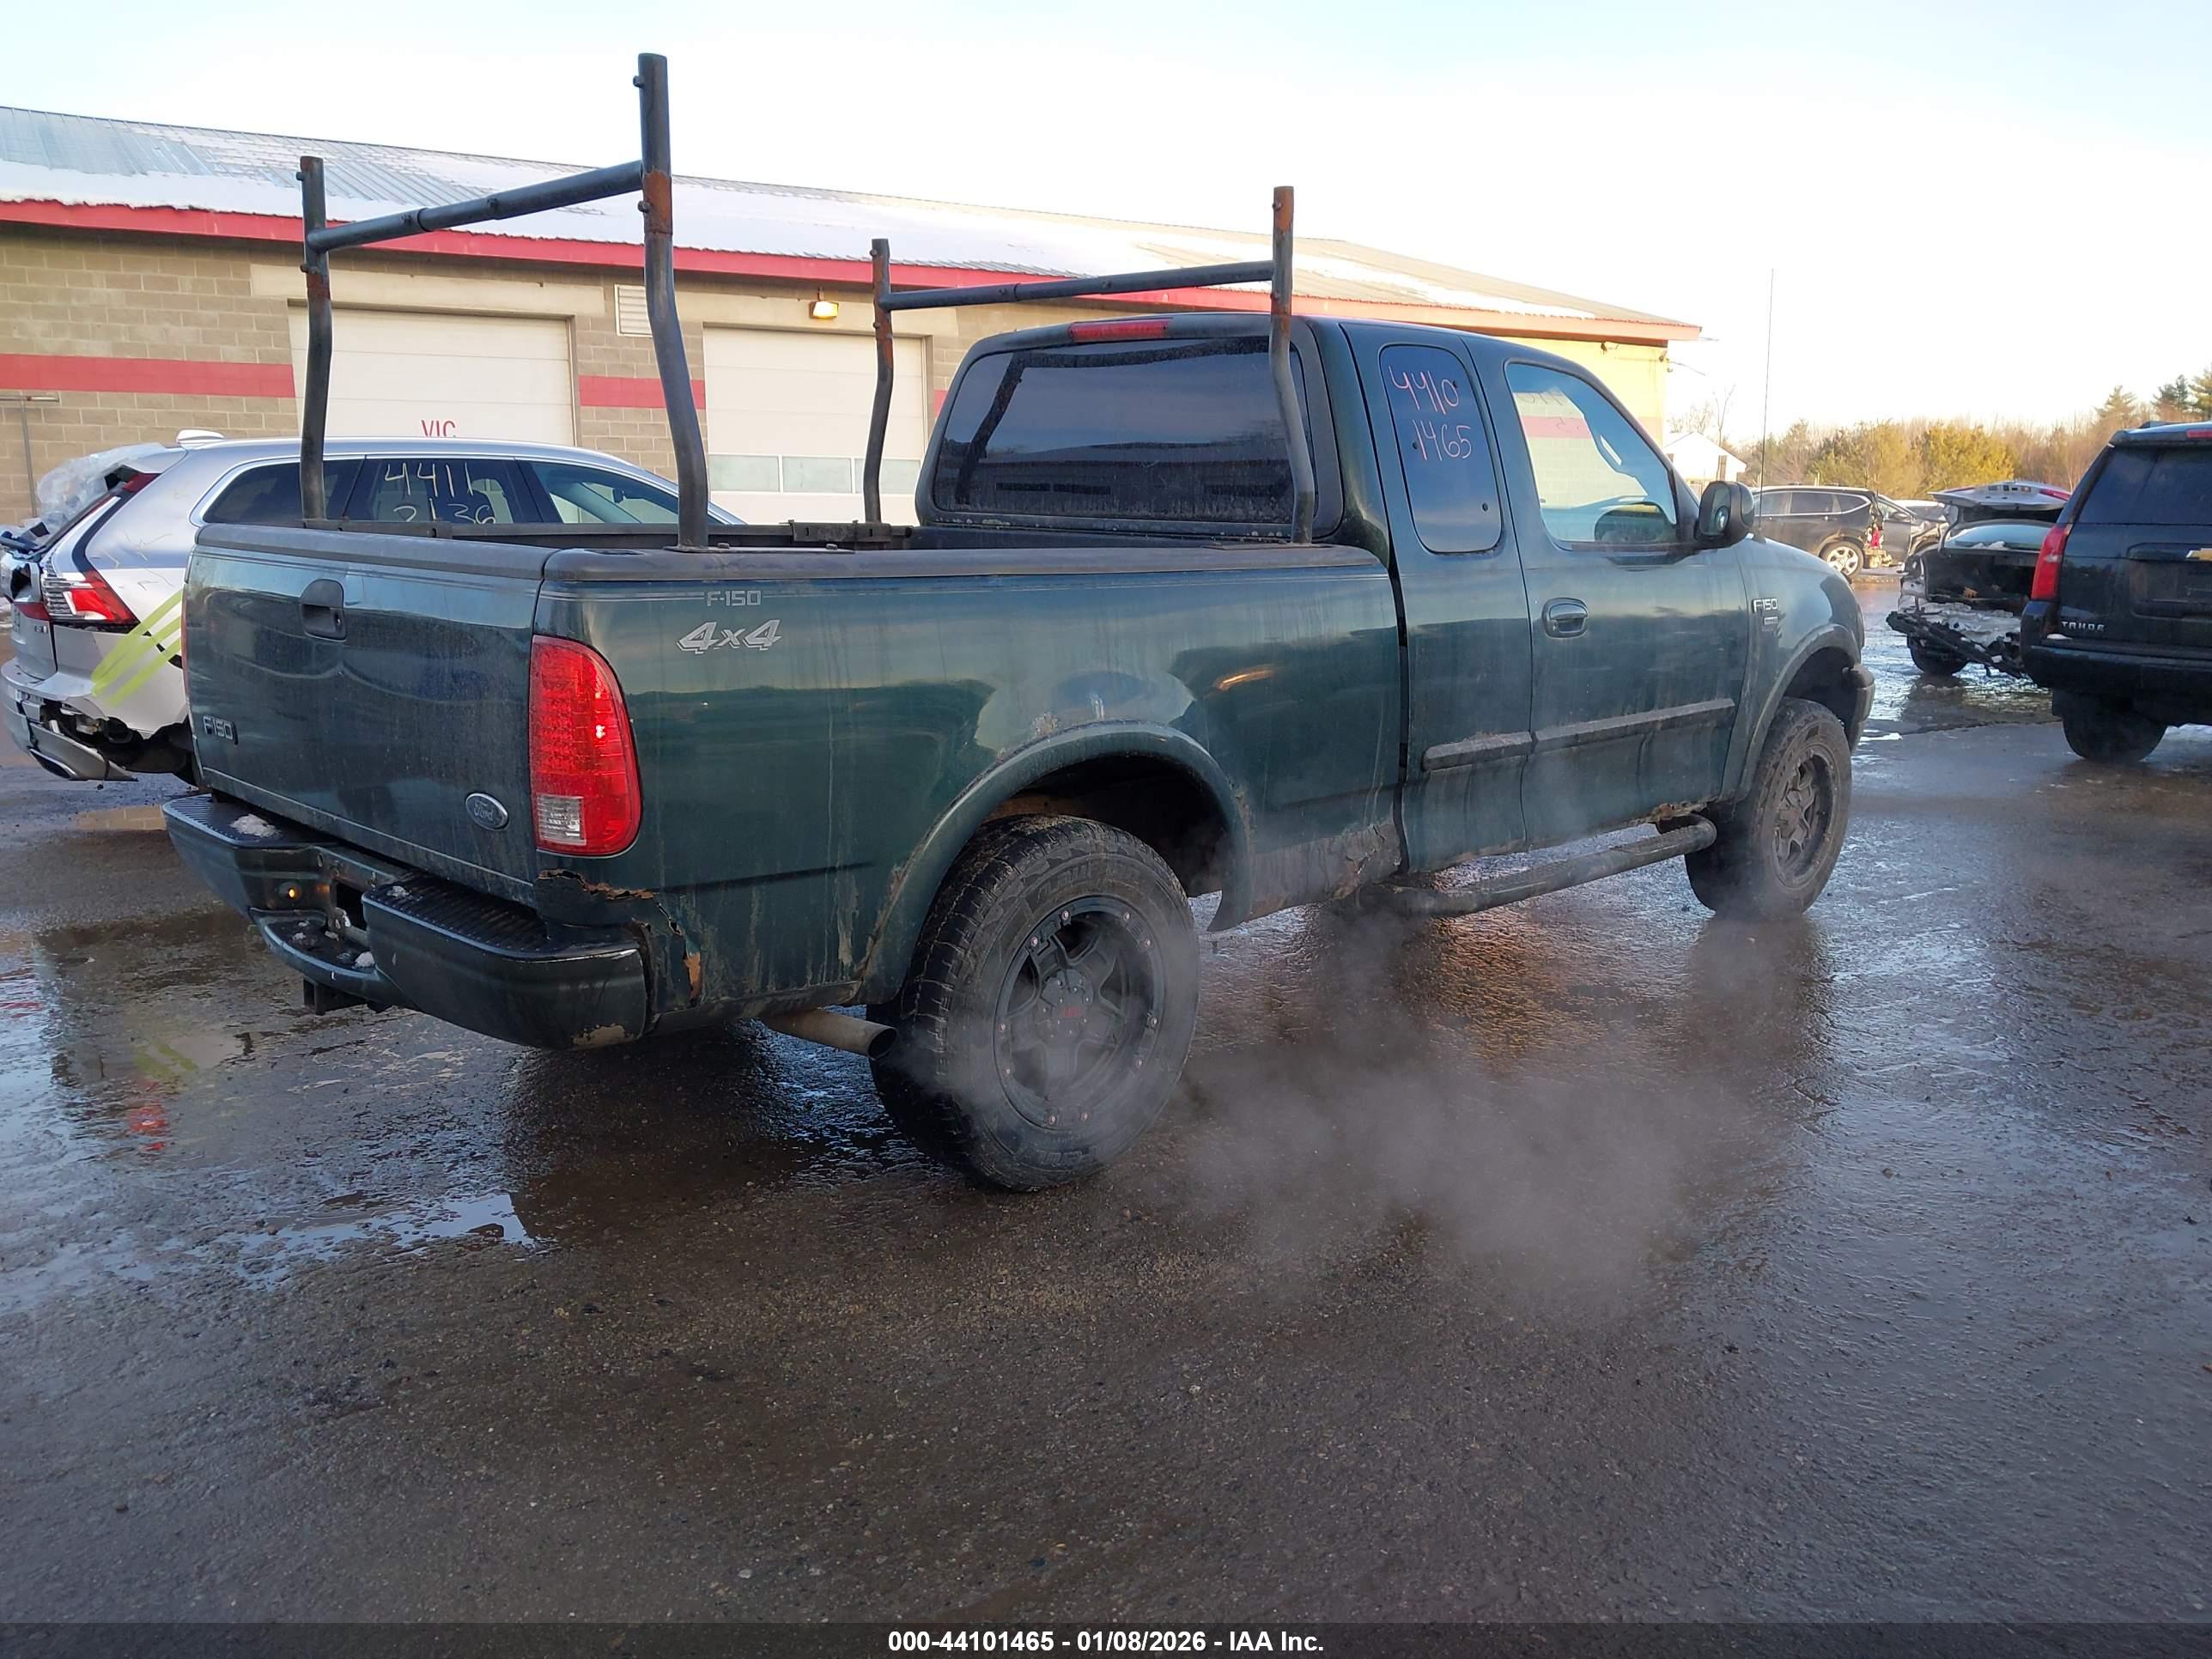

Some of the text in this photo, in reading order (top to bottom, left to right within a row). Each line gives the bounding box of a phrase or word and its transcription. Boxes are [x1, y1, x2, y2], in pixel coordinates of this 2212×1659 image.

[1388, 365, 1460, 416] 4410
[1412, 419, 1473, 461] 1465
[385, 462, 474, 497] 4411
[707, 590, 762, 606] F-150
[676, 619, 783, 654] 4x4
[2061, 621, 2106, 631] TAHOE
